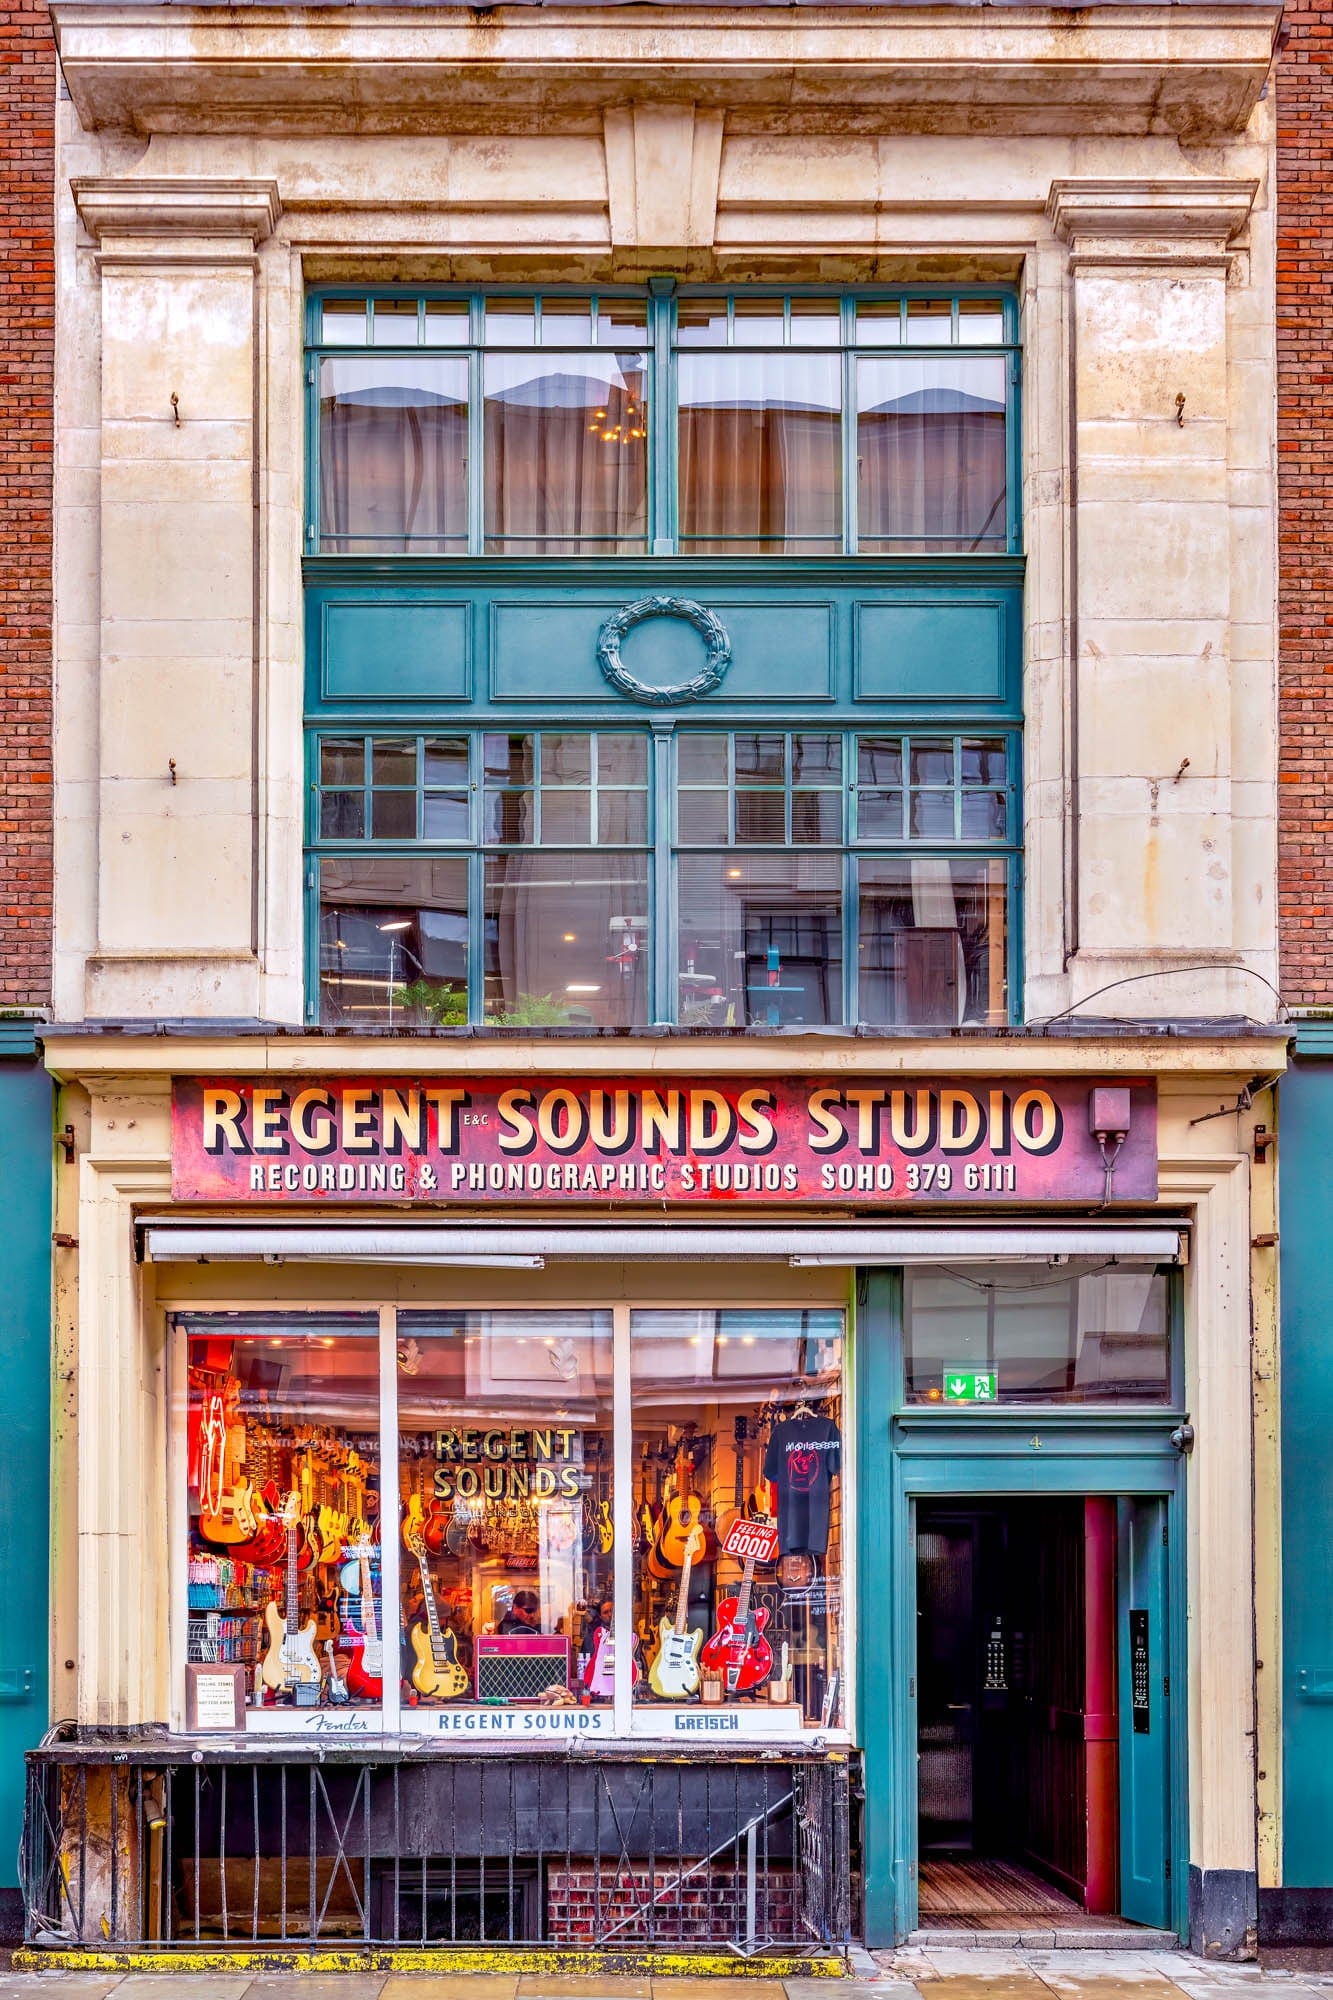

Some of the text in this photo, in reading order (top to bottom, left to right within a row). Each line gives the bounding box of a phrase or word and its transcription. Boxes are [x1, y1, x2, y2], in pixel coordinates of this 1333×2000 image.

[203, 1088, 1063, 1155] REGENT E&C SOUNDS STUDIO
[250, 1163, 1017, 1191] RECORDING & PHONOGRAPHIC STUDIOS SOHO 379 6111
[435, 1428, 578, 1462] REGENT
[1028, 1434, 1042, 1450] 4
[433, 1467, 580, 1499] SOUNDS
[735, 1523, 774, 1539] FEELING
[727, 1532, 771, 1558] GOOD
[305, 1713, 368, 1731] Fender
[439, 1714, 602, 1730] REGENT SOUNDS
[675, 1714, 739, 1730] GRETSCH
